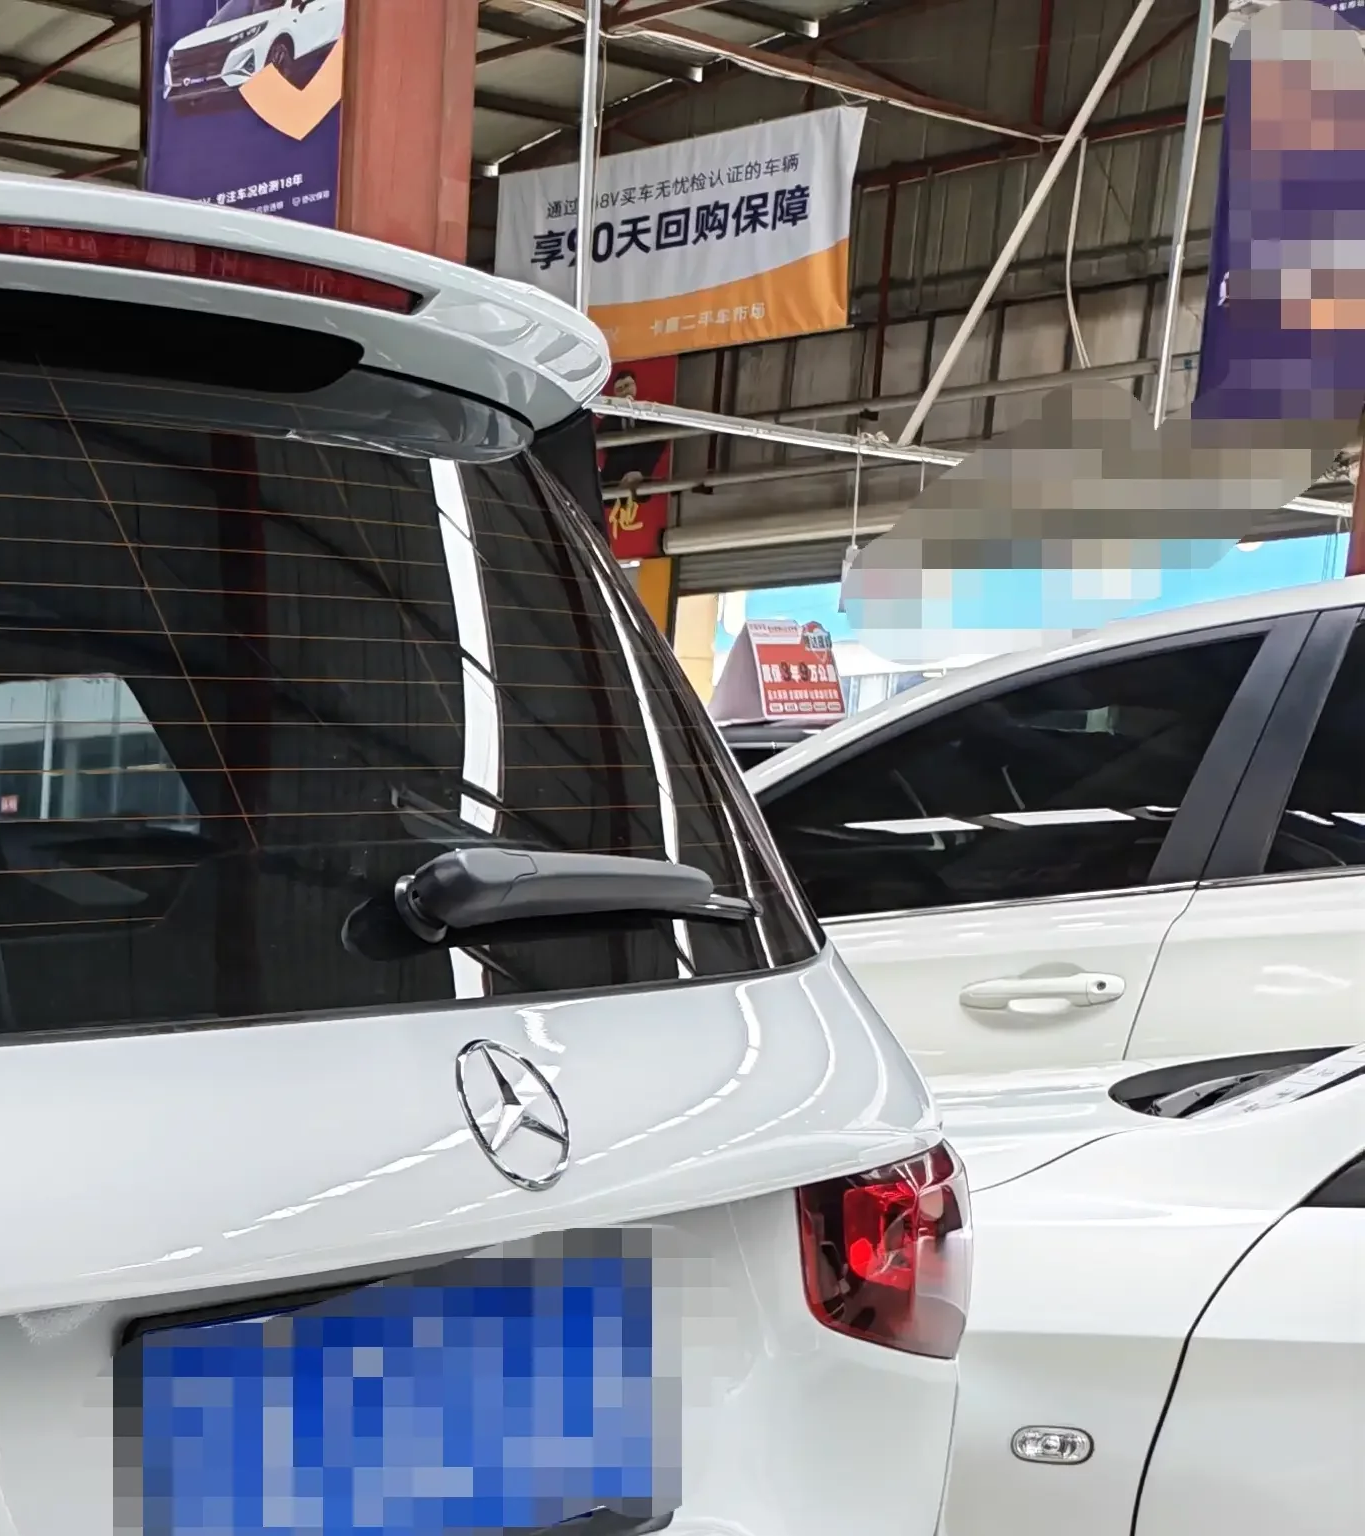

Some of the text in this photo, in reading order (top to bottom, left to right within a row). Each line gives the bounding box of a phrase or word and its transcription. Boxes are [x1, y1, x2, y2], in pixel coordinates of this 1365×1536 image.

[545, 152, 801, 220] 通过8V买车无忧检认证的车辆
